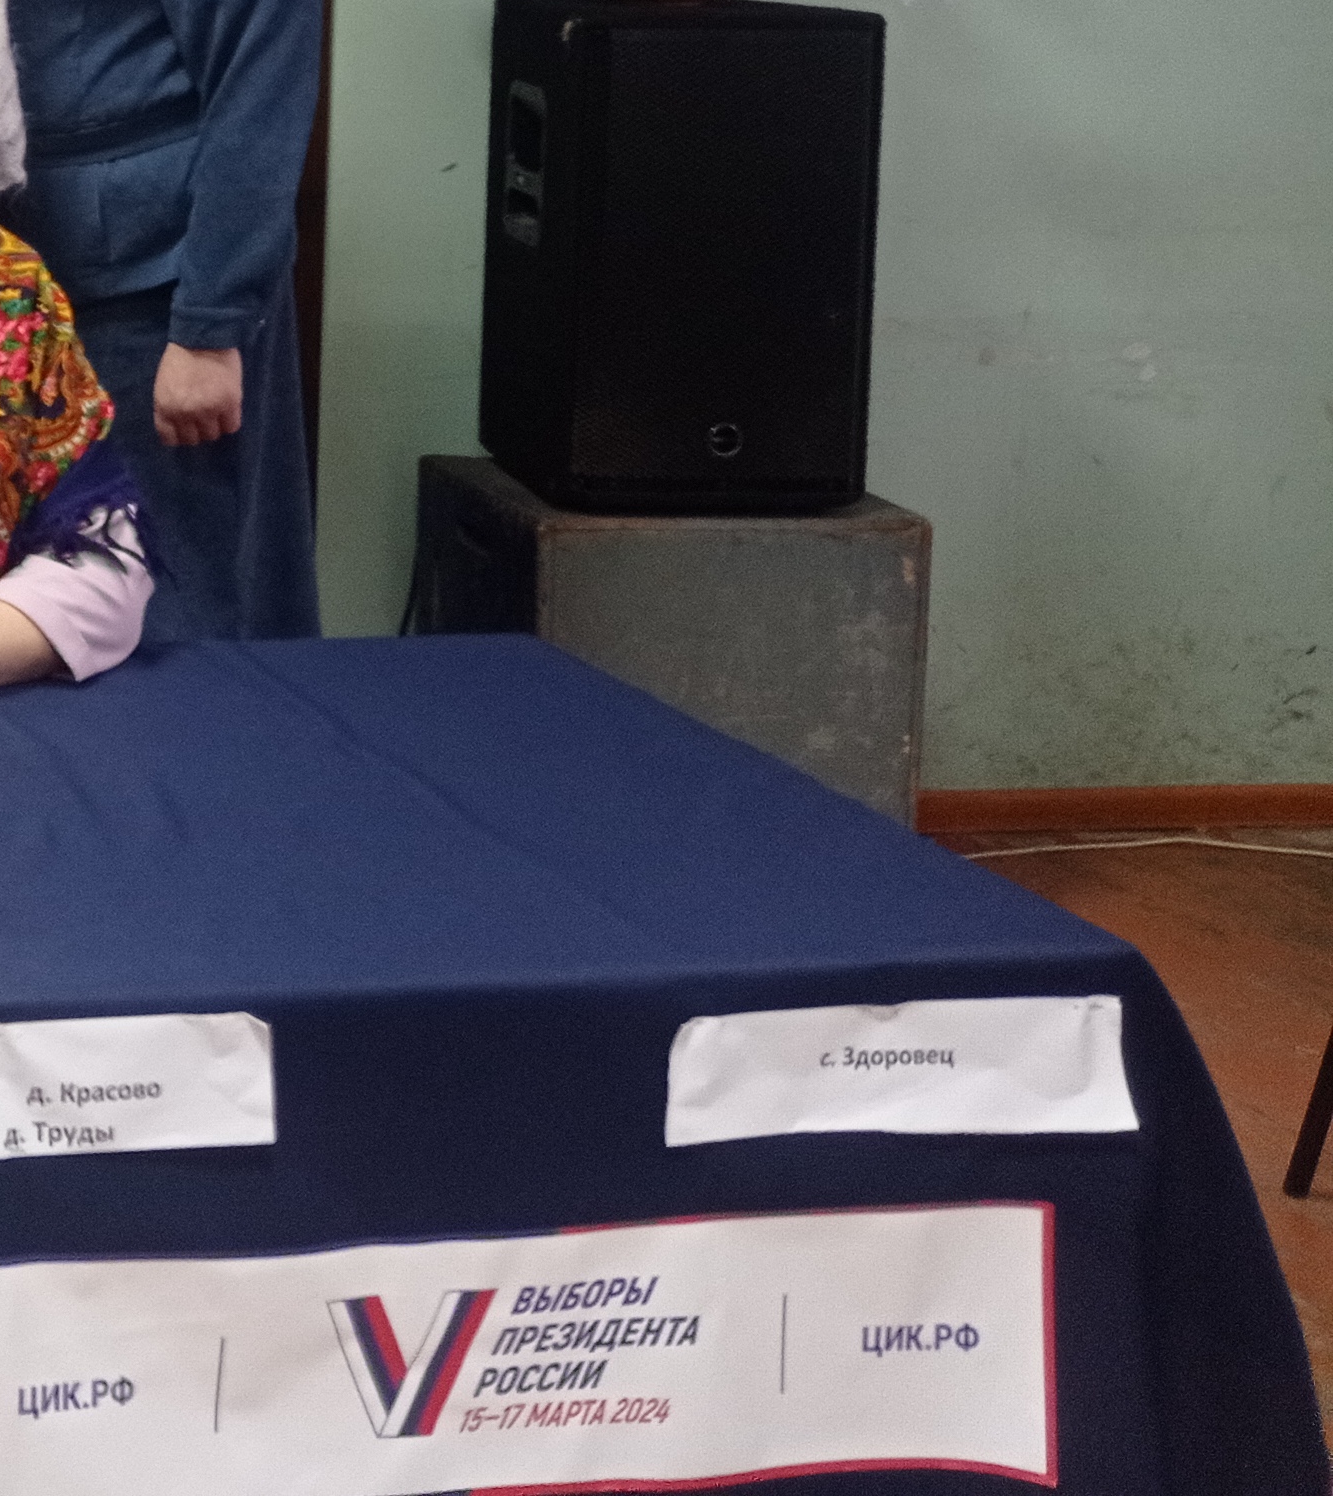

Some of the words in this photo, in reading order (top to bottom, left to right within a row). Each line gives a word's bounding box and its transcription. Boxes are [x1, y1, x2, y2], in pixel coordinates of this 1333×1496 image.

[842, 1045, 955, 1071] Здоровец
[26, 1086, 52, 1107] д.
[59, 1081, 163, 1107] Красово
[3, 1127, 25, 1150] д.
[33, 1120, 115, 1147] Труды
[510, 1276, 658, 1316] ВЫБОРЫ
[490, 1315, 701, 1356] ПРЕЗИДЕНТА
[861, 1323, 980, 1357] ЦИК.РФ
[473, 1359, 608, 1398] РОССИИ
[18, 1377, 135, 1419] ЦИК.РФ
[524, 1400, 606, 1429] МАРТА
[609, 1397, 672, 1425] 2024
